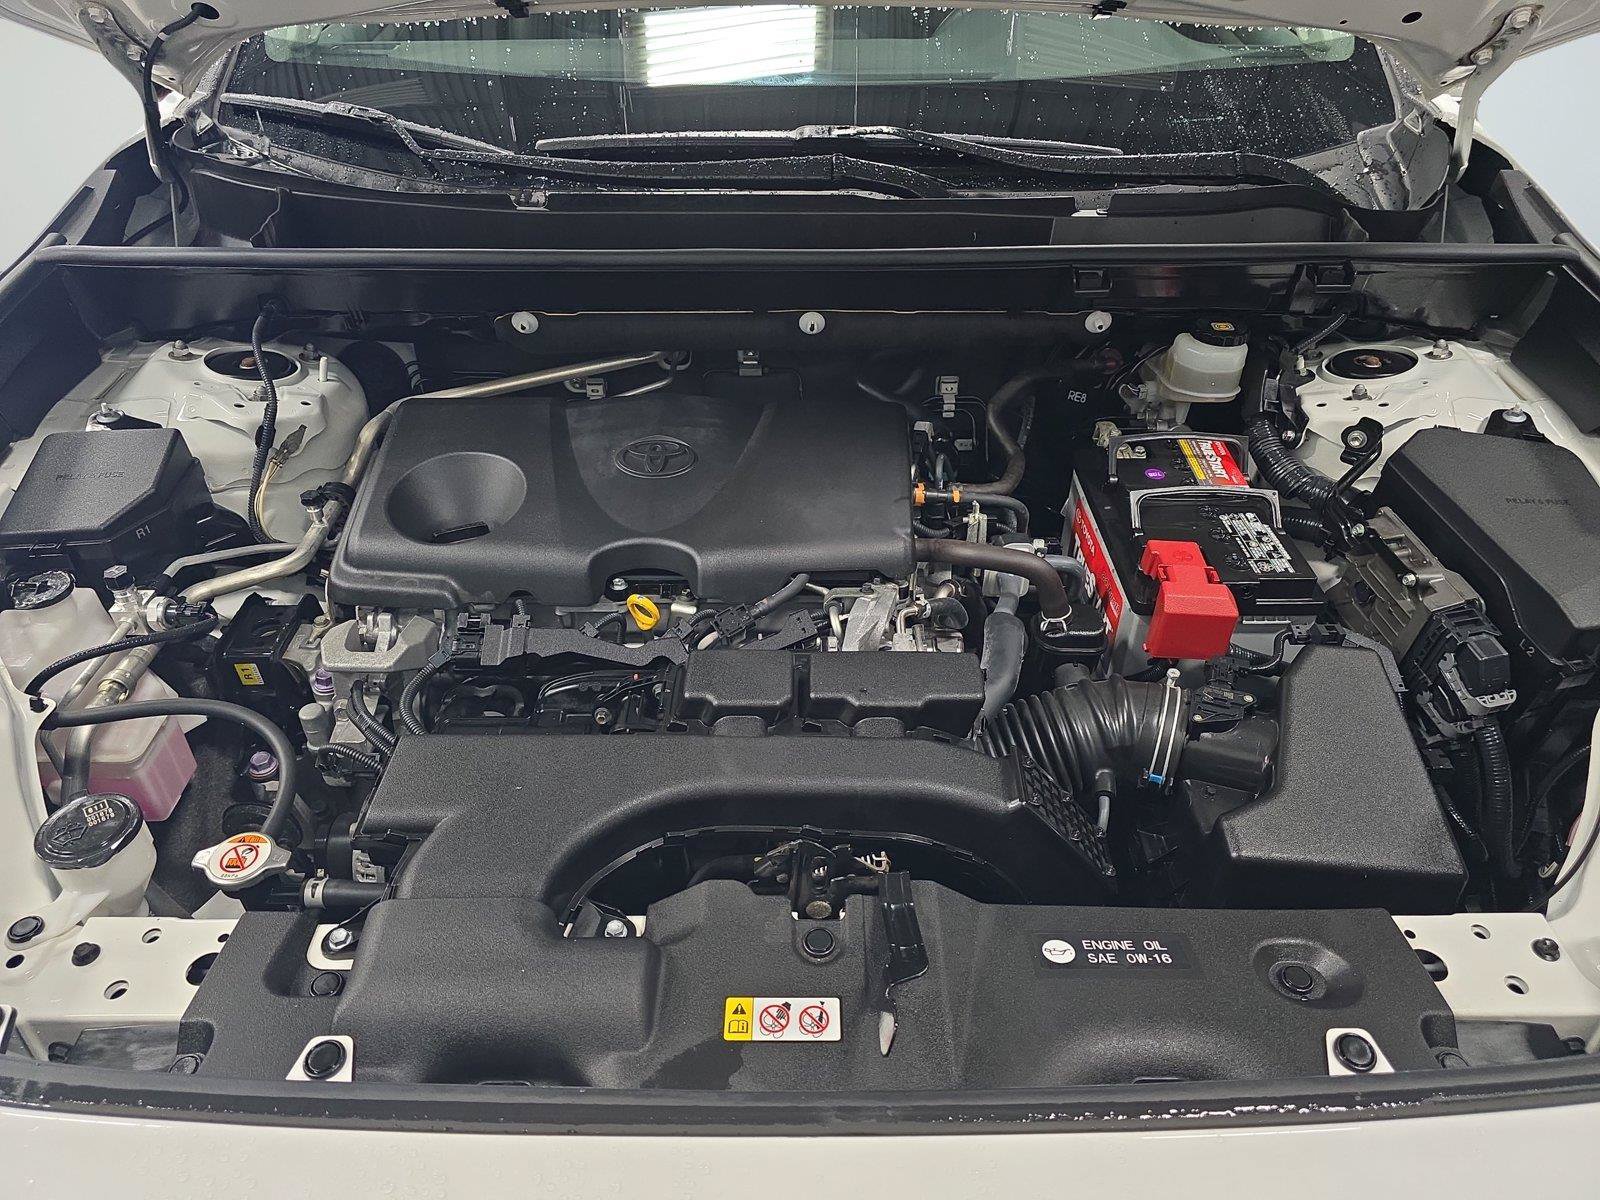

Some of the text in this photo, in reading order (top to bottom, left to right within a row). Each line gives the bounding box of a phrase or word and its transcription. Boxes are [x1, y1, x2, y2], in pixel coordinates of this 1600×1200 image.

[1067, 390, 1087, 403] RE8
[136, 524, 151, 539] R1
[241, 667, 254, 680] R1
[1081, 939, 1168, 951] ENGINE OIL
[1087, 953, 1173, 964] SAE 0W-16
